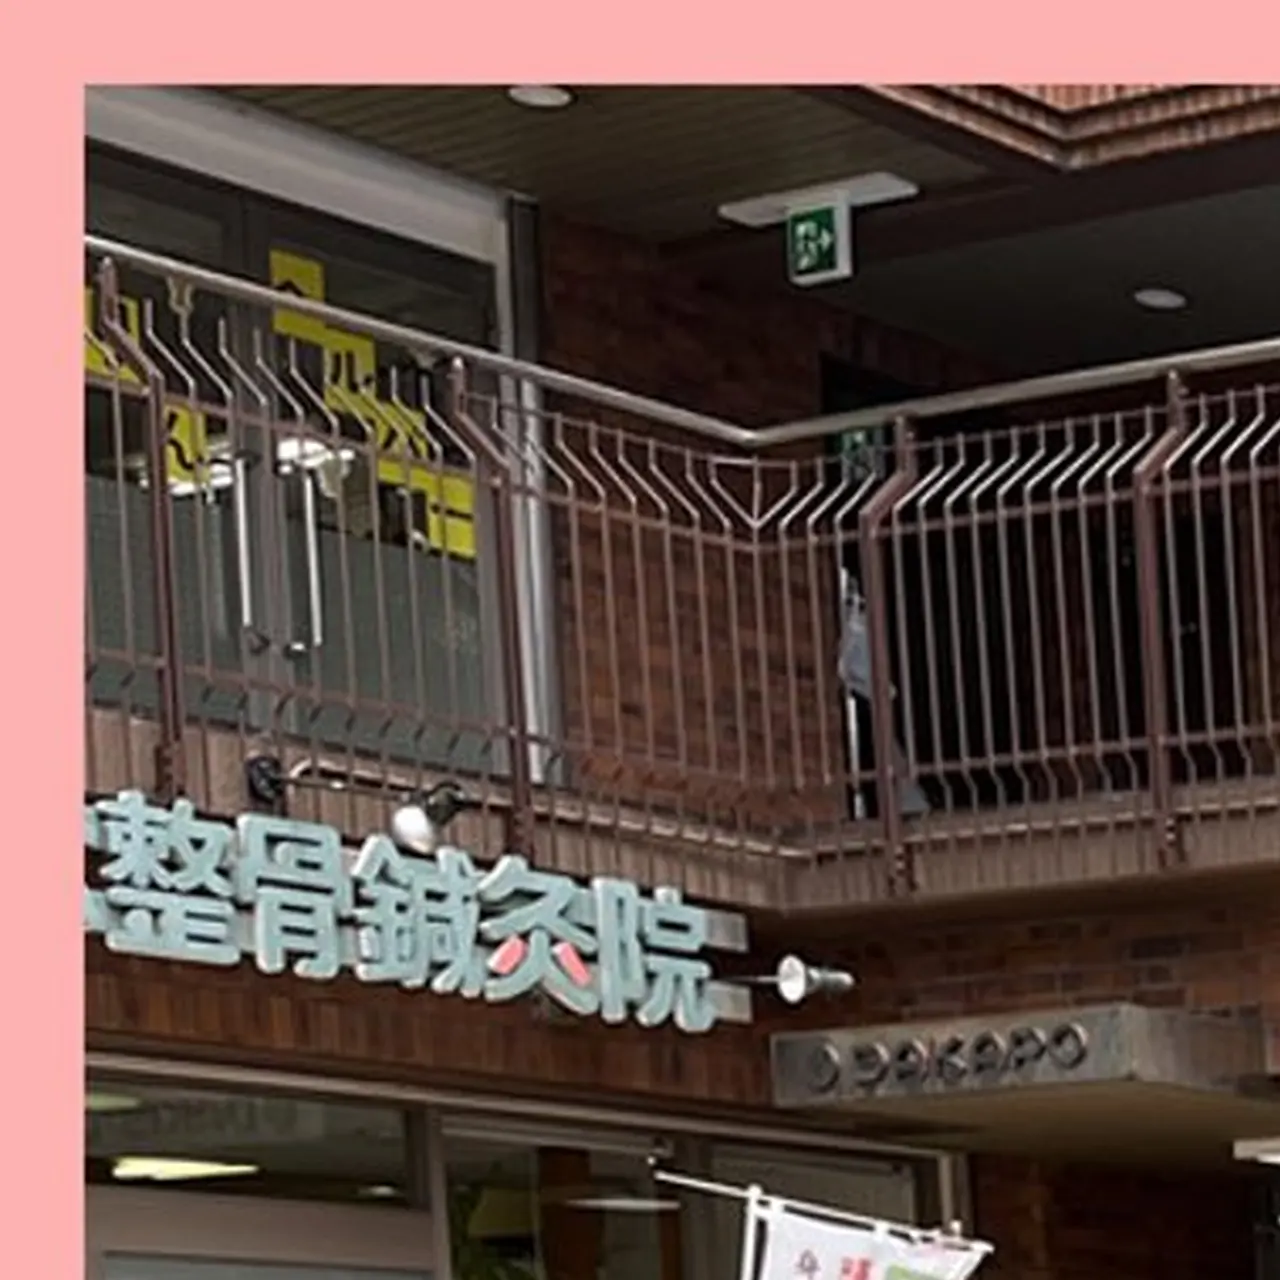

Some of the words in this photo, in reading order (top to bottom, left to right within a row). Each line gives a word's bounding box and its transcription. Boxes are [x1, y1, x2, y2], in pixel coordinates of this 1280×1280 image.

[95, 788, 716, 1033] 整骨鍼灸院
